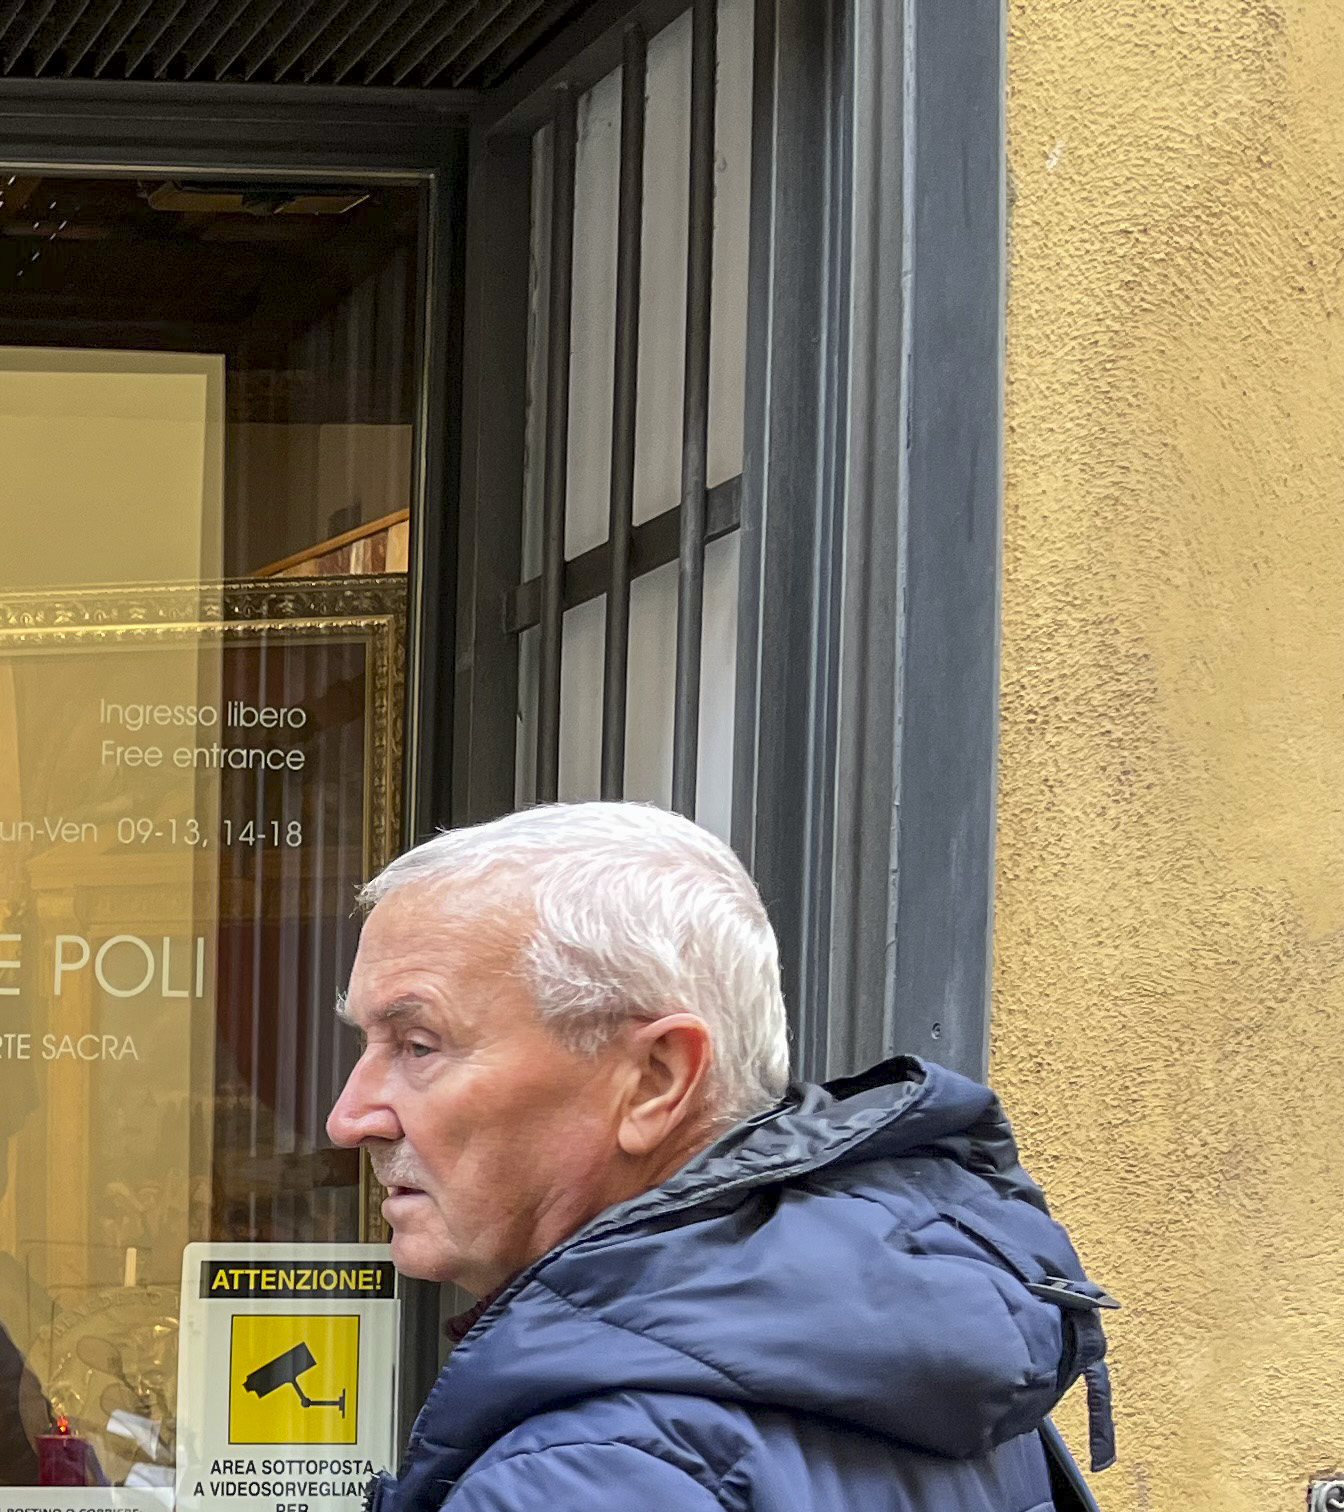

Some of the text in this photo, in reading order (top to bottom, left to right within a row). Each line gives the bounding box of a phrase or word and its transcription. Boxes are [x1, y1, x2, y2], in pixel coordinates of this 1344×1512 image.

[100, 698, 306, 731] Ingresso libero
[102, 741, 306, 770] Free entrance
[117, 817, 209, 848] 09-13,
[223, 819, 302, 847] 14-18
[53, 935, 204, 999] POLI
[42, 1034, 139, 1061] SACRA
[212, 1269, 382, 1290] ATTENZIONE!
[210, 1460, 374, 1475] AREA SOTTOPOSTA
[193, 1482, 365, 1497] A VIDEOSORVEGLIAN
